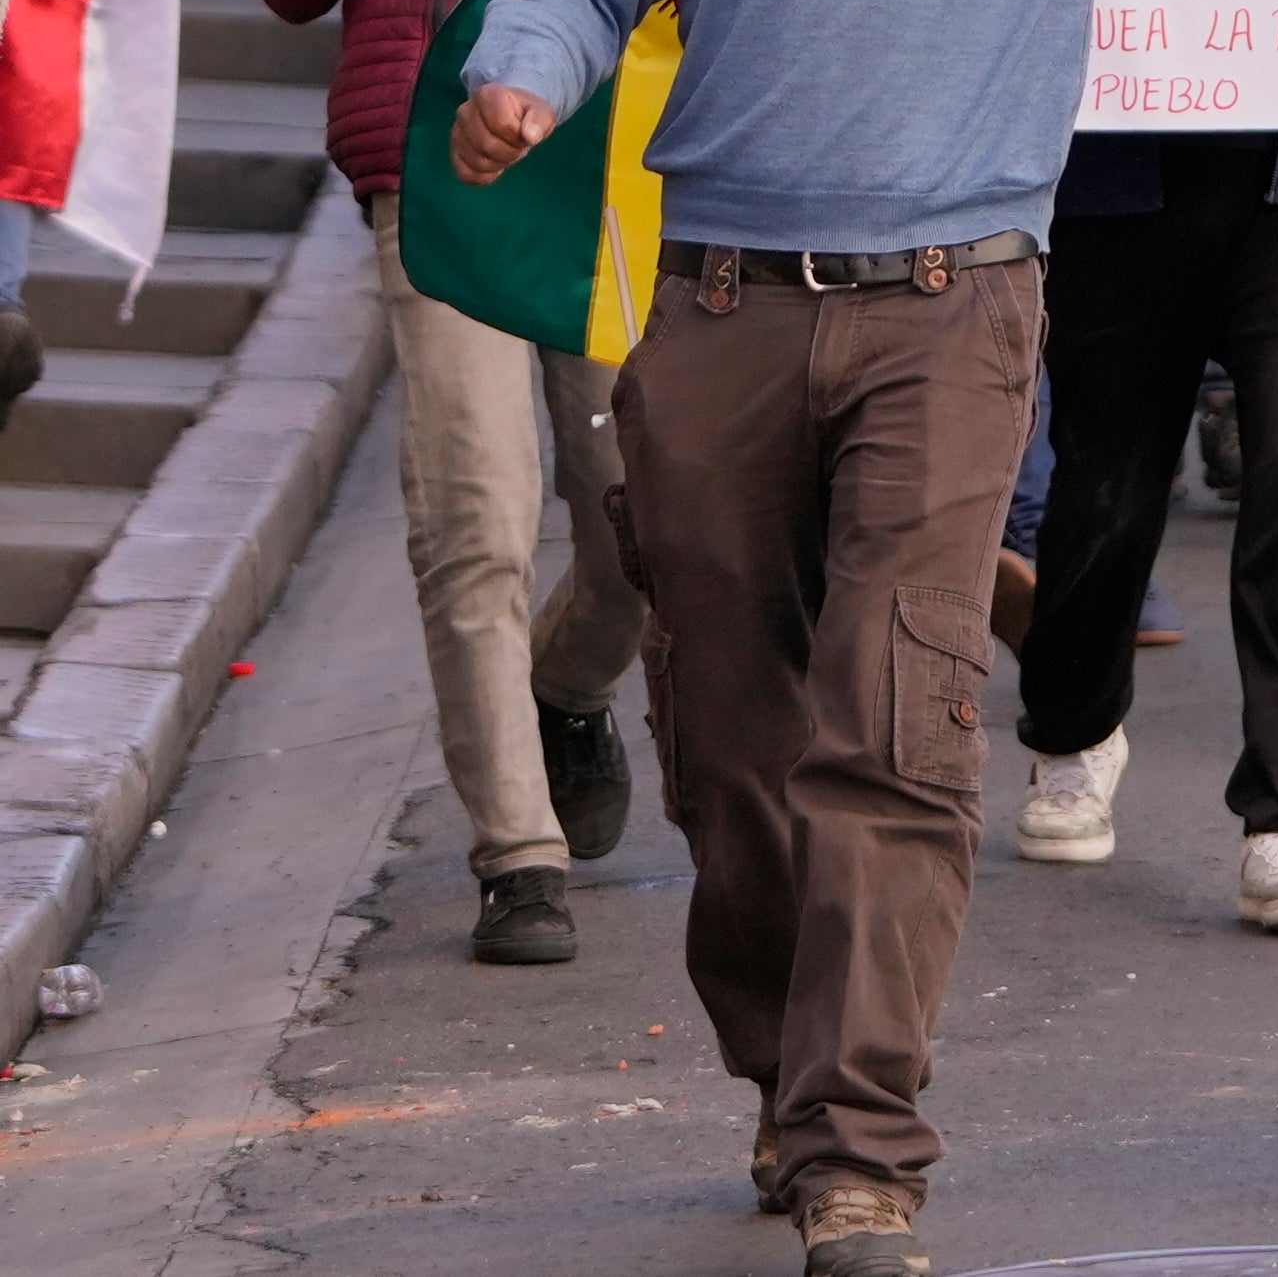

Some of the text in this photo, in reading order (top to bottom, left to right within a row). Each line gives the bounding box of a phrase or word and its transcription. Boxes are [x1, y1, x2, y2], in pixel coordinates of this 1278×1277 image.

[1088, 7, 1168, 52] UEA
[1204, 8, 1253, 52] LA
[1091, 72, 1240, 114] PUEBLO
